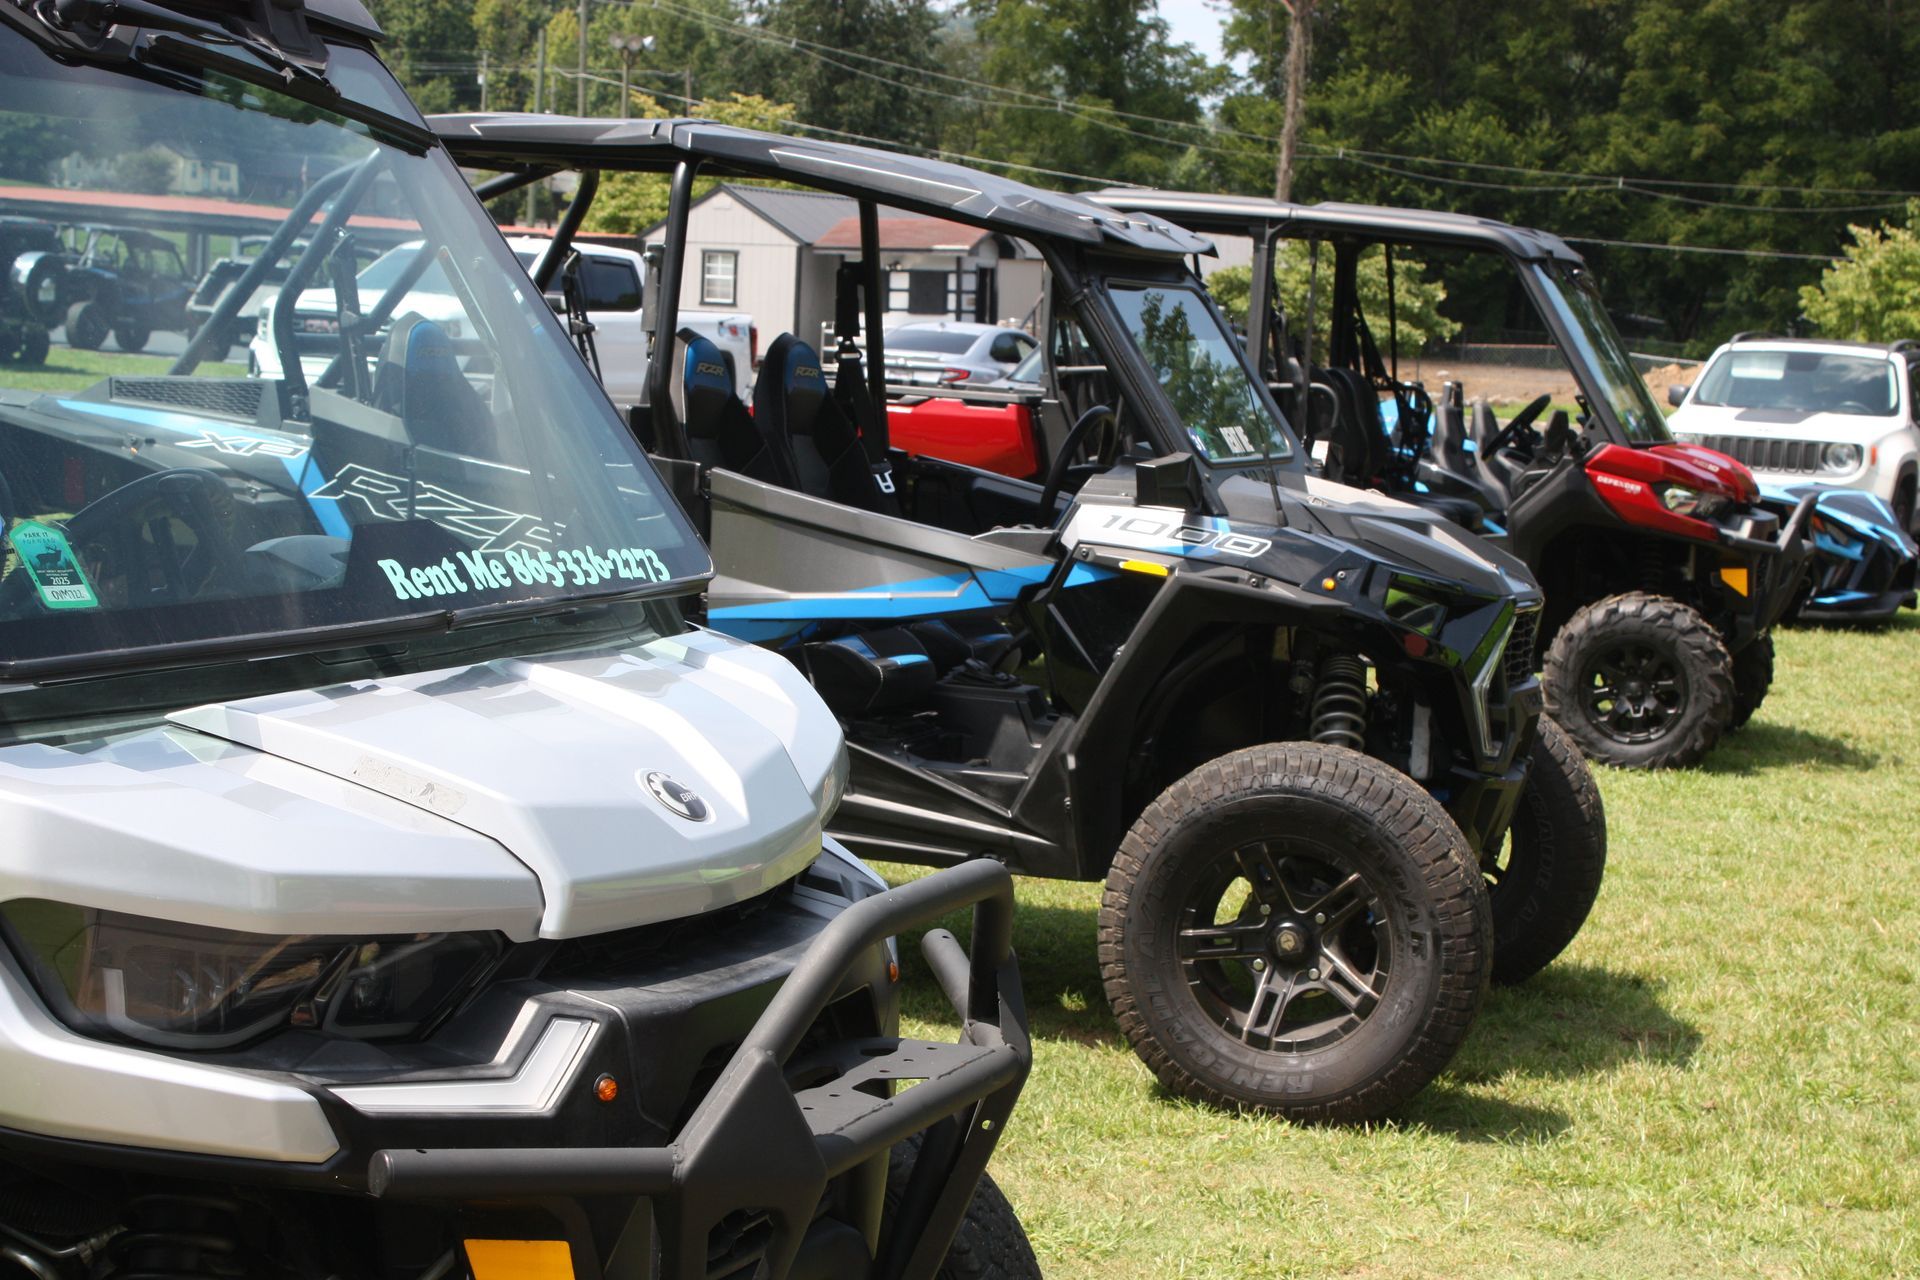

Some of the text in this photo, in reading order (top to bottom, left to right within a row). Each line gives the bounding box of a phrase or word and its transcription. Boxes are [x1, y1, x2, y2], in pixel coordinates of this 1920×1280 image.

[697, 363, 724, 376] RZR
[796, 366, 819, 378] RZR
[174, 430, 311, 459] XP
[1596, 475, 1642, 491] DEFENDER
[1102, 514, 1272, 557] 1000
[50, 577, 70, 585] 2025
[378, 546, 671, 600] Rent Me 865-336-2273
